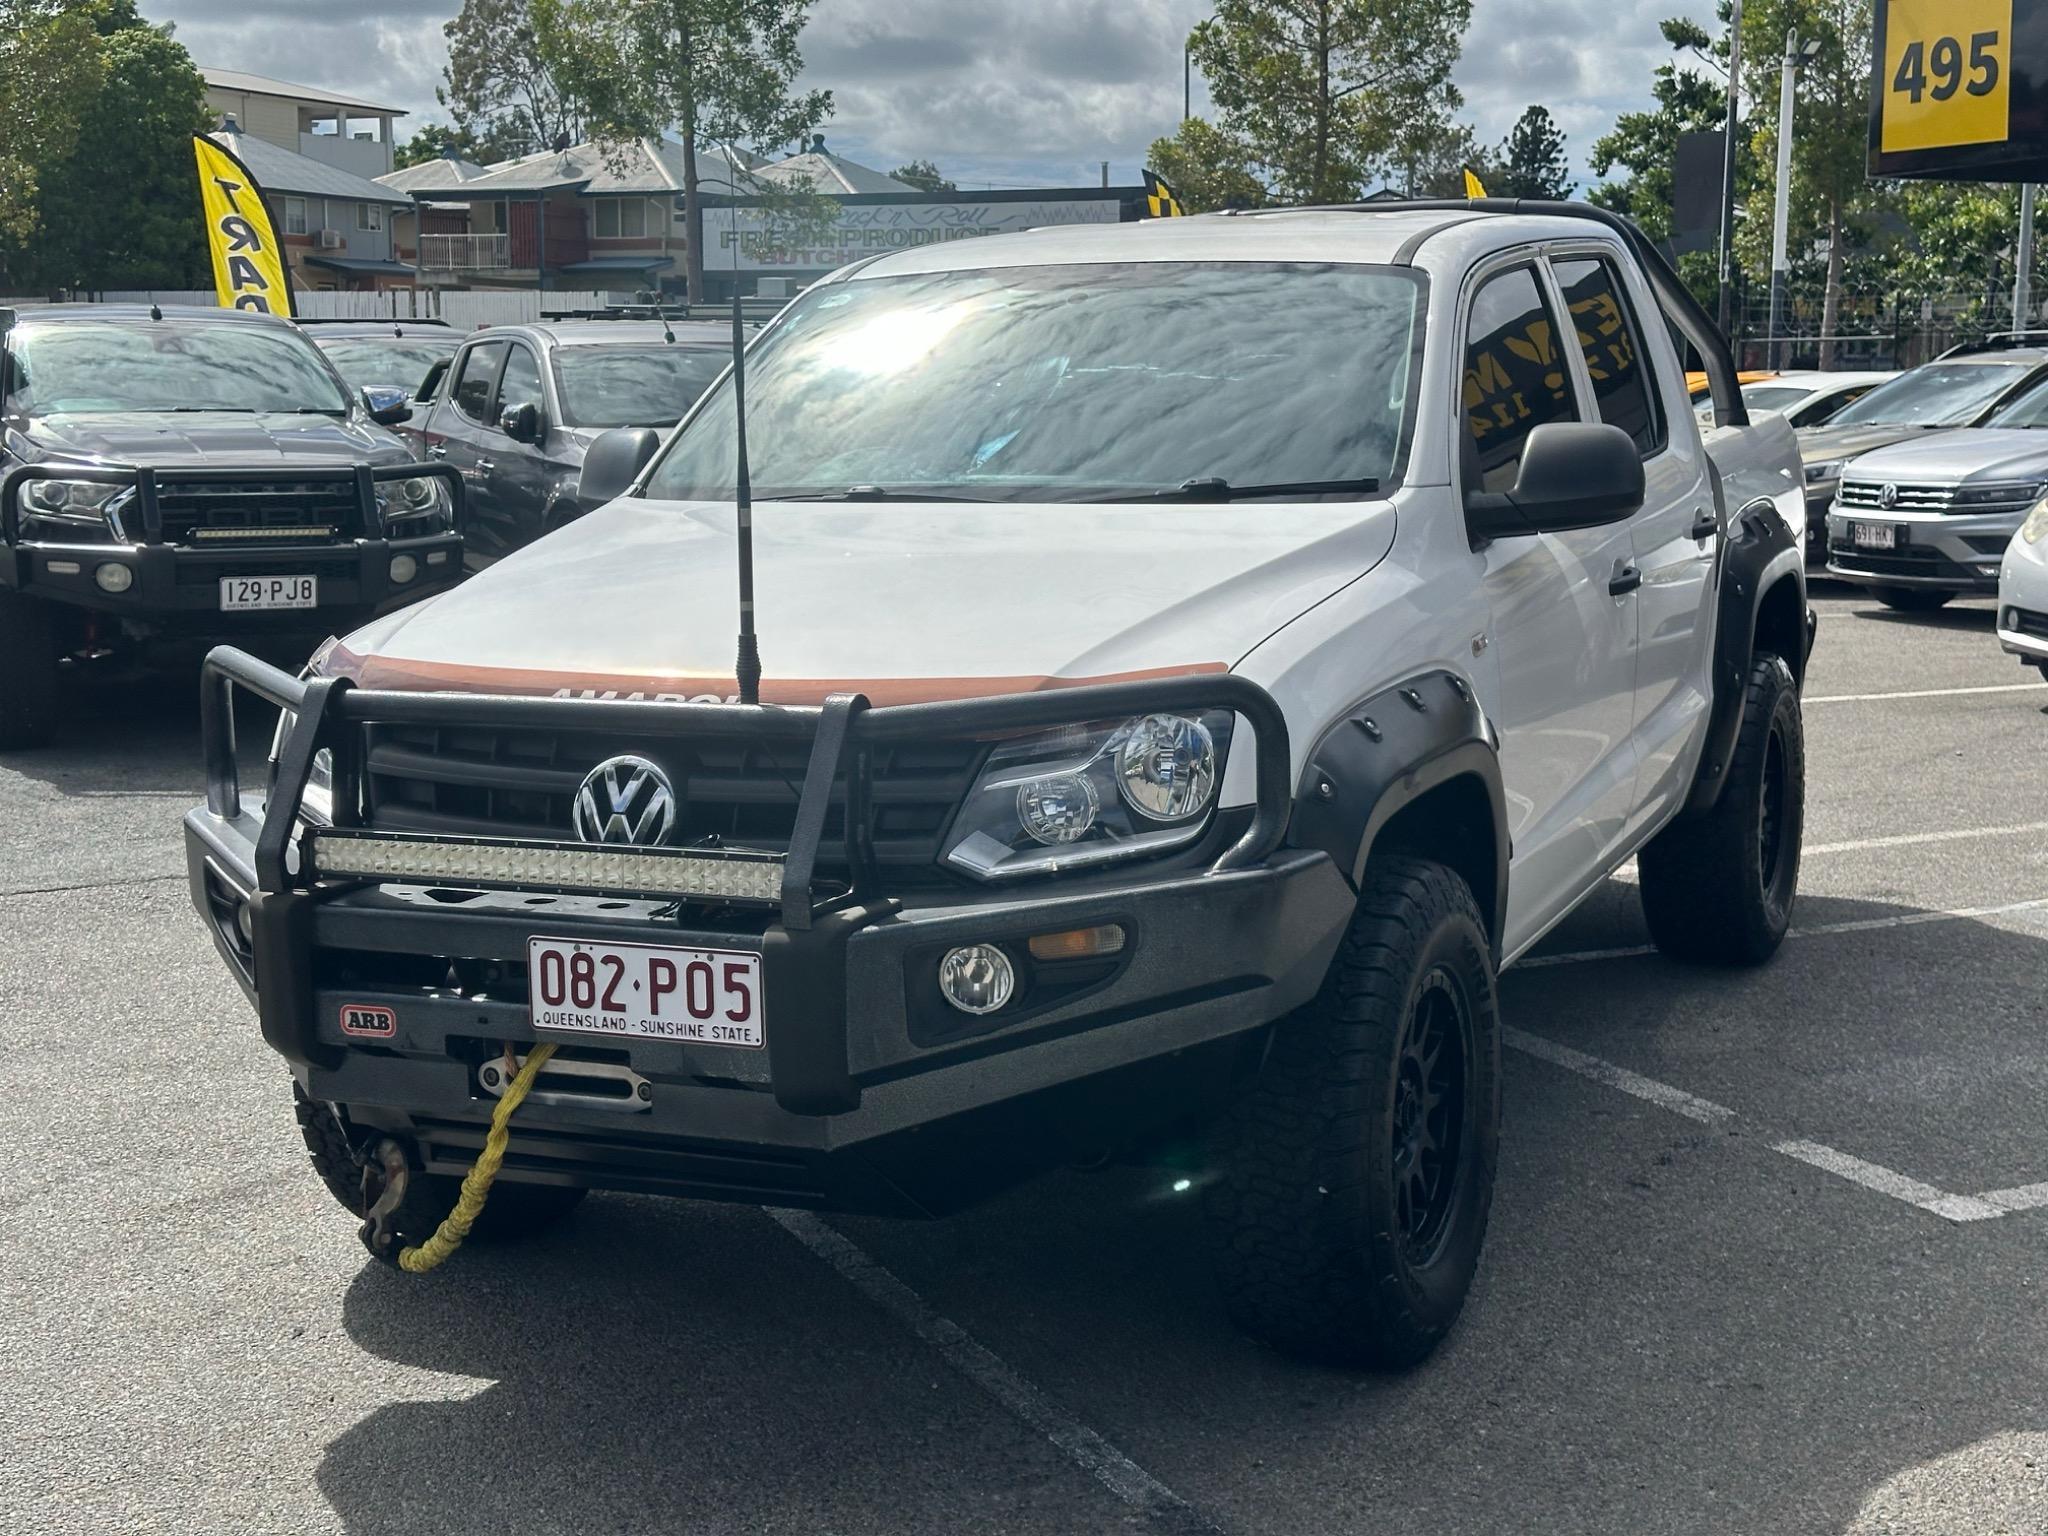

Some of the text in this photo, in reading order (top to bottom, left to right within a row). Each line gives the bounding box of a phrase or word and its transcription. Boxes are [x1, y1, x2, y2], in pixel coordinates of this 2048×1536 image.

[1893, 31, 1999, 104] 495
[348, 1011, 390, 1030] ARB
[543, 1011, 626, 1031] QUEENSLAND
[640, 1020, 705, 1038] SUNSHINE
[712, 1026, 751, 1041] STATE
